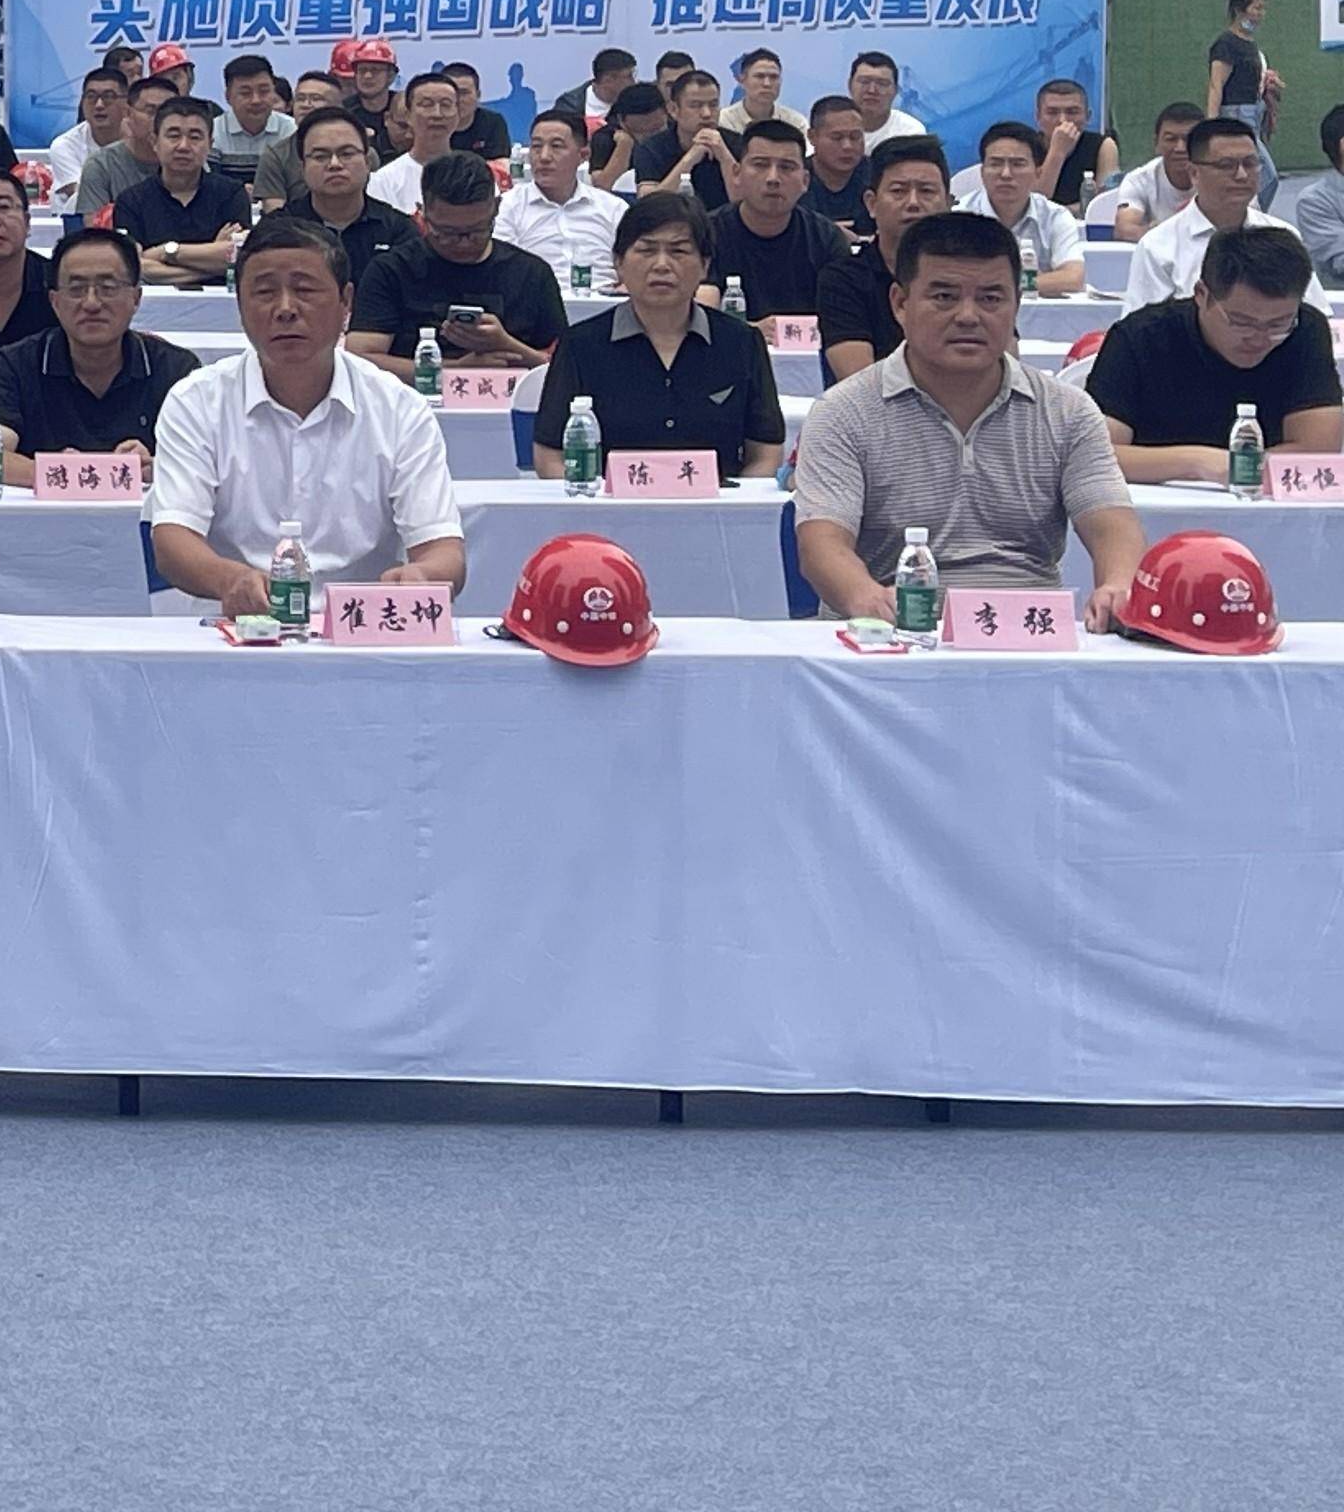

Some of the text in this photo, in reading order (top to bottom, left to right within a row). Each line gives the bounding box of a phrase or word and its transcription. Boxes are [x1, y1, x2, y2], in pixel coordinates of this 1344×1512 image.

[45, 464, 134, 491] 游海涛
[339, 595, 444, 635] 崔志坤
[973, 601, 1056, 636] 李强
